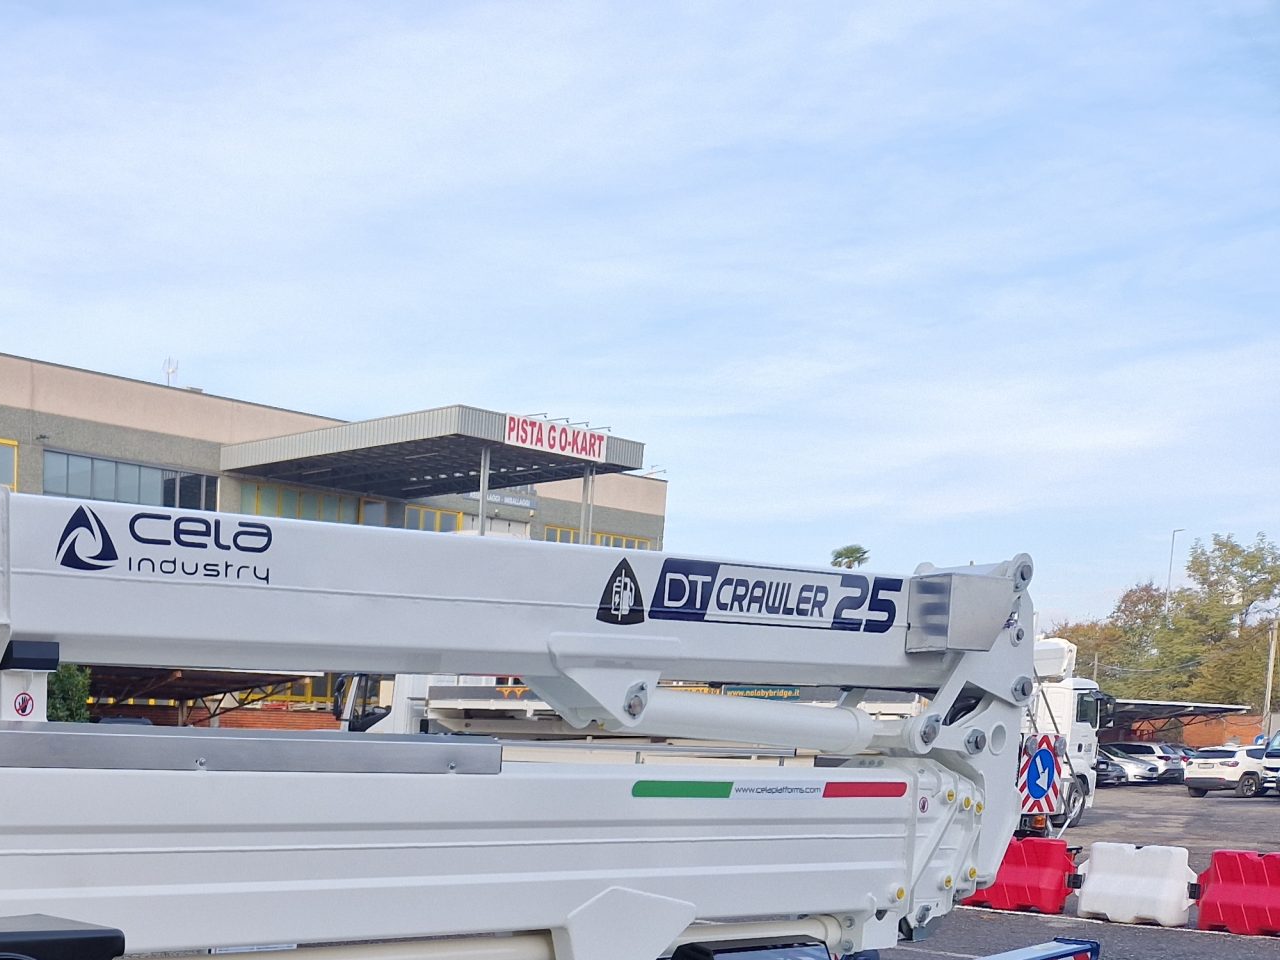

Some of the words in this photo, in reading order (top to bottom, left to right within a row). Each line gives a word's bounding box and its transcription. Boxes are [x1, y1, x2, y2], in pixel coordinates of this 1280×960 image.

[508, 416, 544, 448] PISTA
[128, 512, 273, 554] cela
[128, 556, 270, 585] industry
[663, 572, 713, 609] DT
[715, 576, 830, 618] CRAWLER
[831, 573, 905, 634] 25
[734, 785, 822, 795] www.celaplatforms.com
